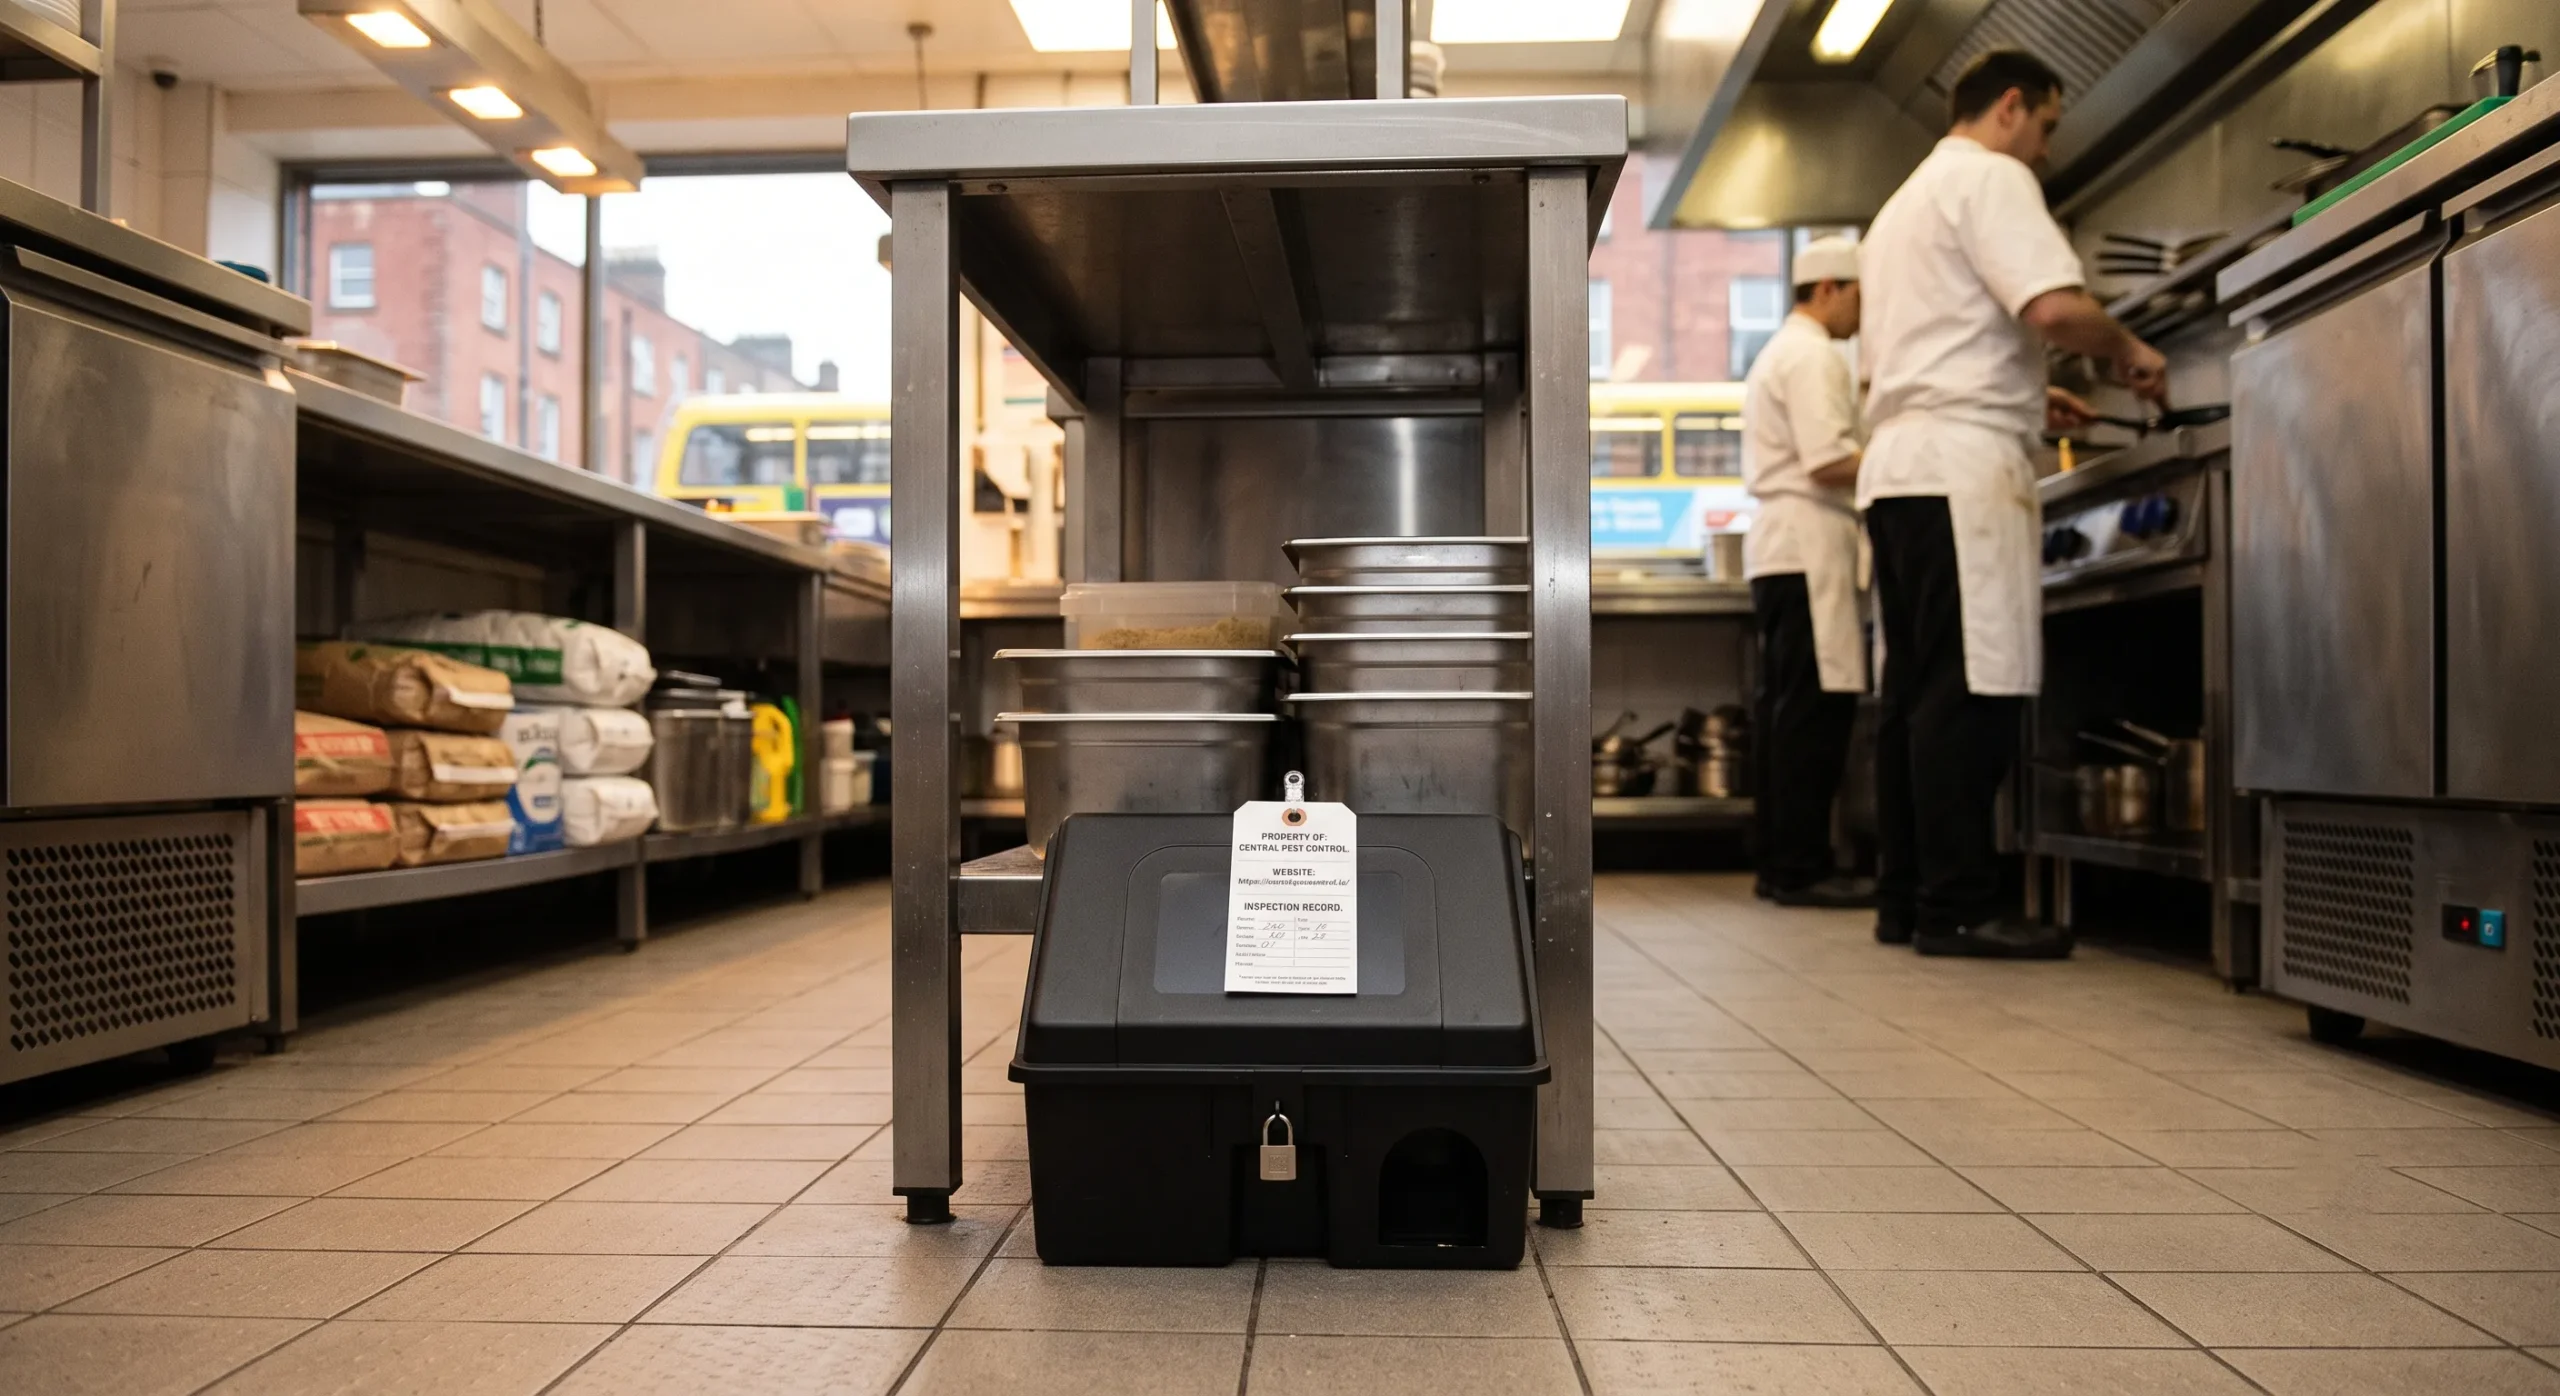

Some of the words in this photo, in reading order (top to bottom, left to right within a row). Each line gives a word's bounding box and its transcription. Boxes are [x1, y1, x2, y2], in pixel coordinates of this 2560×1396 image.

[1261, 832, 1310, 841] PROPERTY
[1312, 833, 1328, 841] OF:
[1239, 844, 1279, 852] CENTRAL
[1281, 844, 1304, 852] PEST
[1305, 845, 1350, 853] CONTROL.
[1272, 868, 1316, 876] WEBSITE:
[1244, 902, 1300, 911] INSPECTION
[1302, 903, 1343, 912] RECORD.
